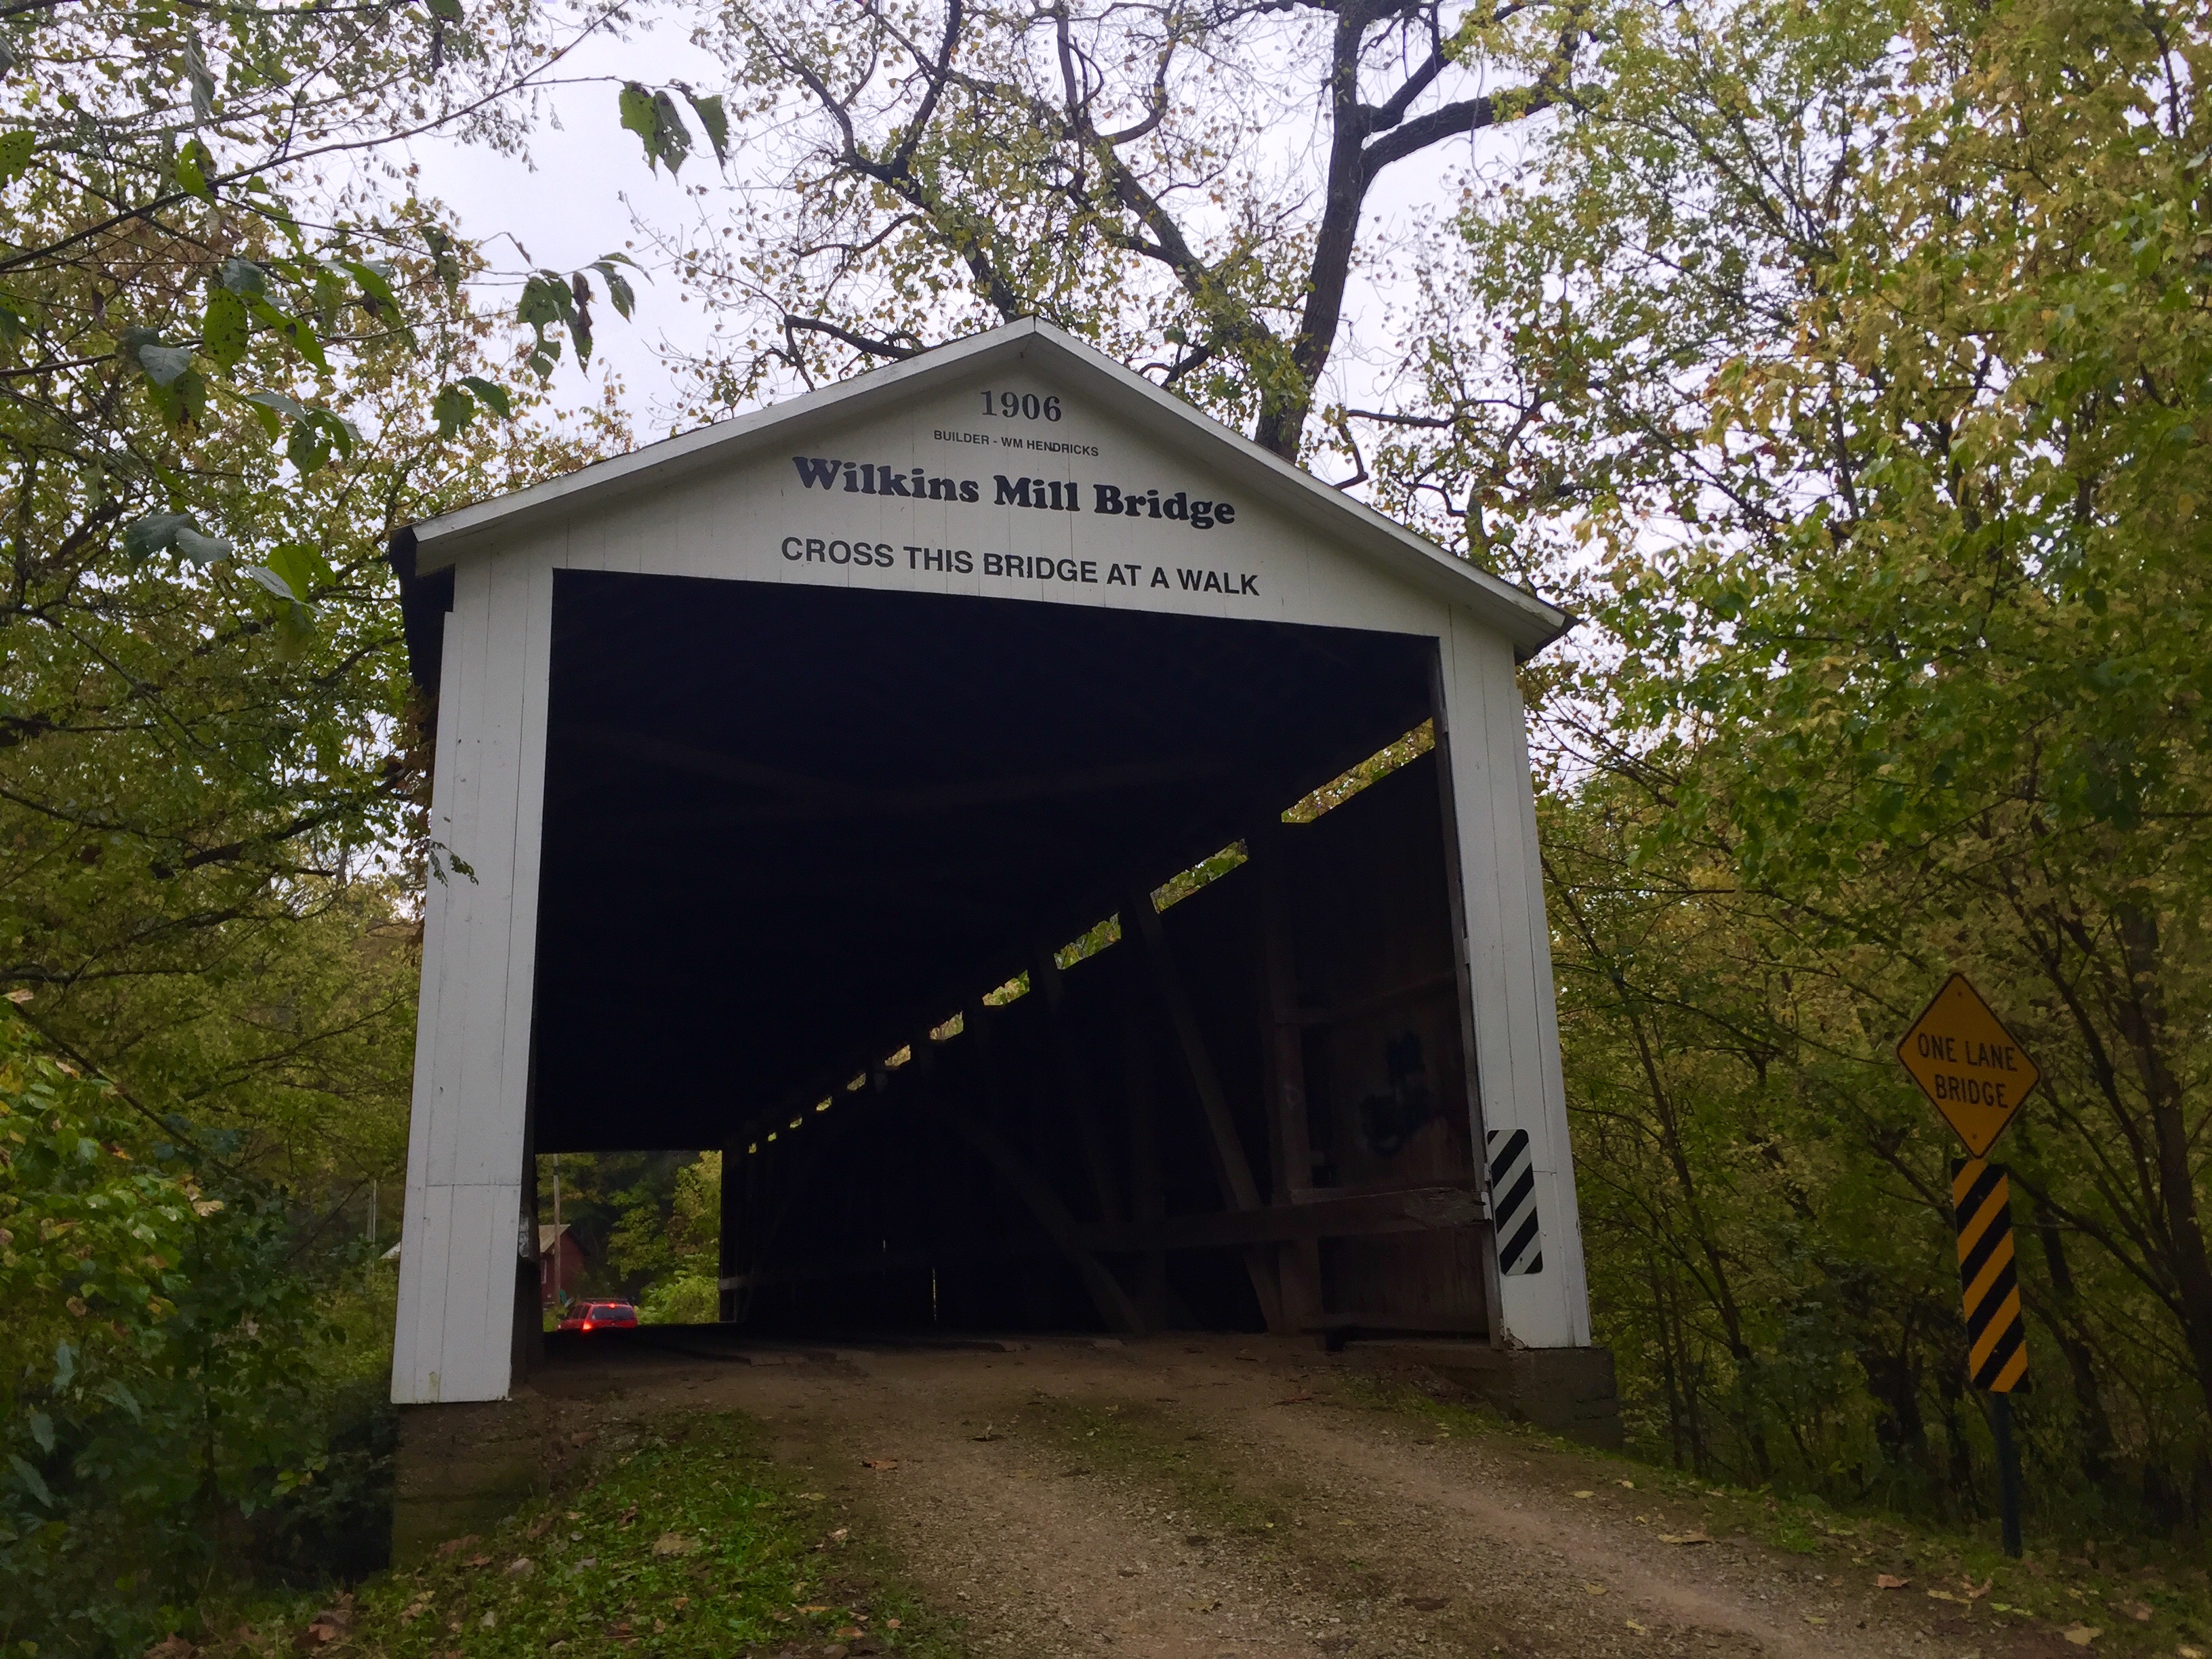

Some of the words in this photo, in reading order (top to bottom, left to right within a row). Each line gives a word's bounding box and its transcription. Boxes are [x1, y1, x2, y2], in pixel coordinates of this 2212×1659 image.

[980, 390, 1062, 422] 1906
[933, 430, 989, 445] BUILDER
[1000, 436, 1023, 449] WM
[1026, 438, 1099, 457] HENDRICKS
[792, 456, 980, 503] Wilkins
[993, 475, 1080, 512] Mill
[1093, 484, 1235, 529] Bridge
[781, 537, 895, 567] CROSS
[903, 546, 973, 573] THIS
[983, 553, 1098, 583] BRIDGE
[1107, 563, 1141, 586] AT
[1150, 567, 1170, 588] A
[1177, 568, 1259, 596] WALK
[1918, 1033, 1957, 1063] ONE
[1965, 1041, 2018, 1071] LANE
[1935, 1074, 2009, 1109] BRIDGE
